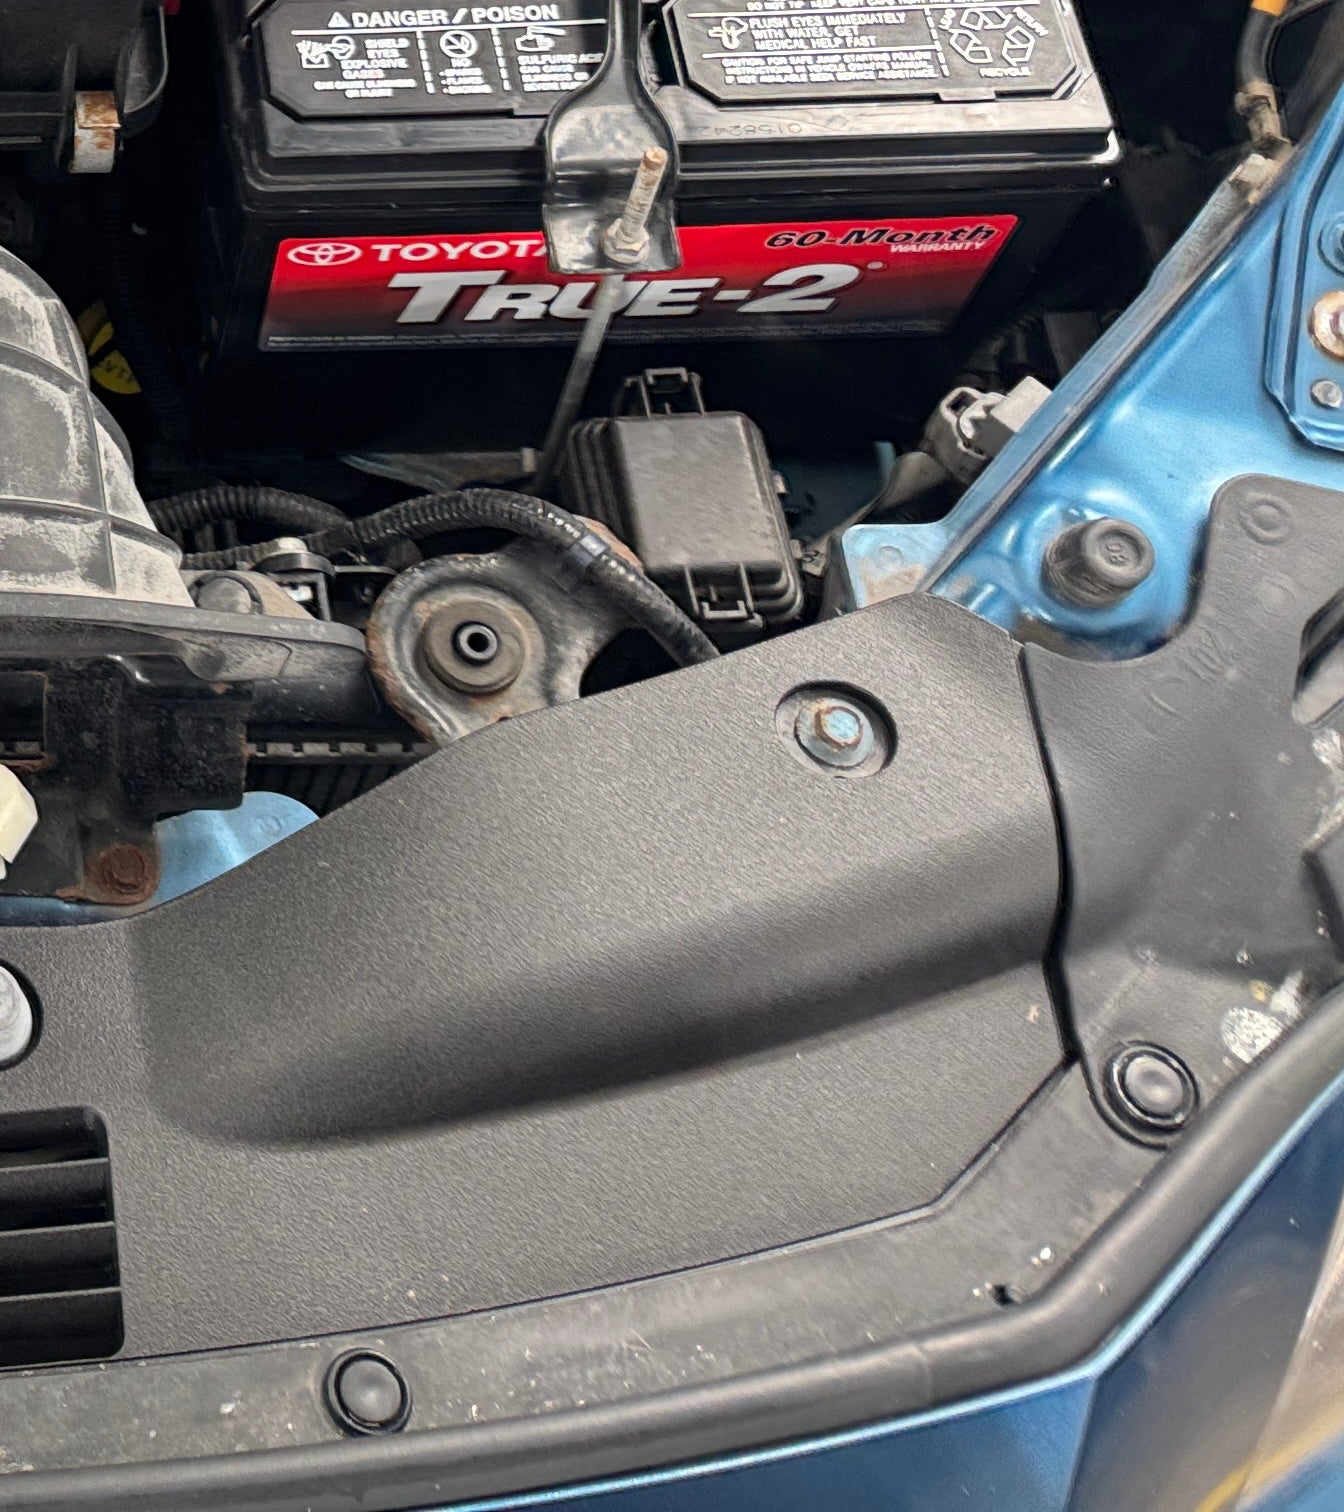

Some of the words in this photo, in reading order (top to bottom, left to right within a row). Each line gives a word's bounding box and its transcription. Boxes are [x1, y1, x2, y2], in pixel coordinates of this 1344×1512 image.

[351, 9, 448, 29] DANGER
[471, 3, 561, 23] POISON
[749, 17, 789, 29] FLUSH
[791, 16, 824, 27] EYES
[825, 12, 906, 26] IMMEDIATELY
[751, 28, 784, 40] WITH
[834, 26, 859, 37] GET
[754, 38, 809, 50] MEDICAL
[810, 37, 844, 49] HELP
[845, 35, 876, 47] FAST
[765, 224, 998, 249] 60-Month
[890, 241, 986, 253] WARRANTY
